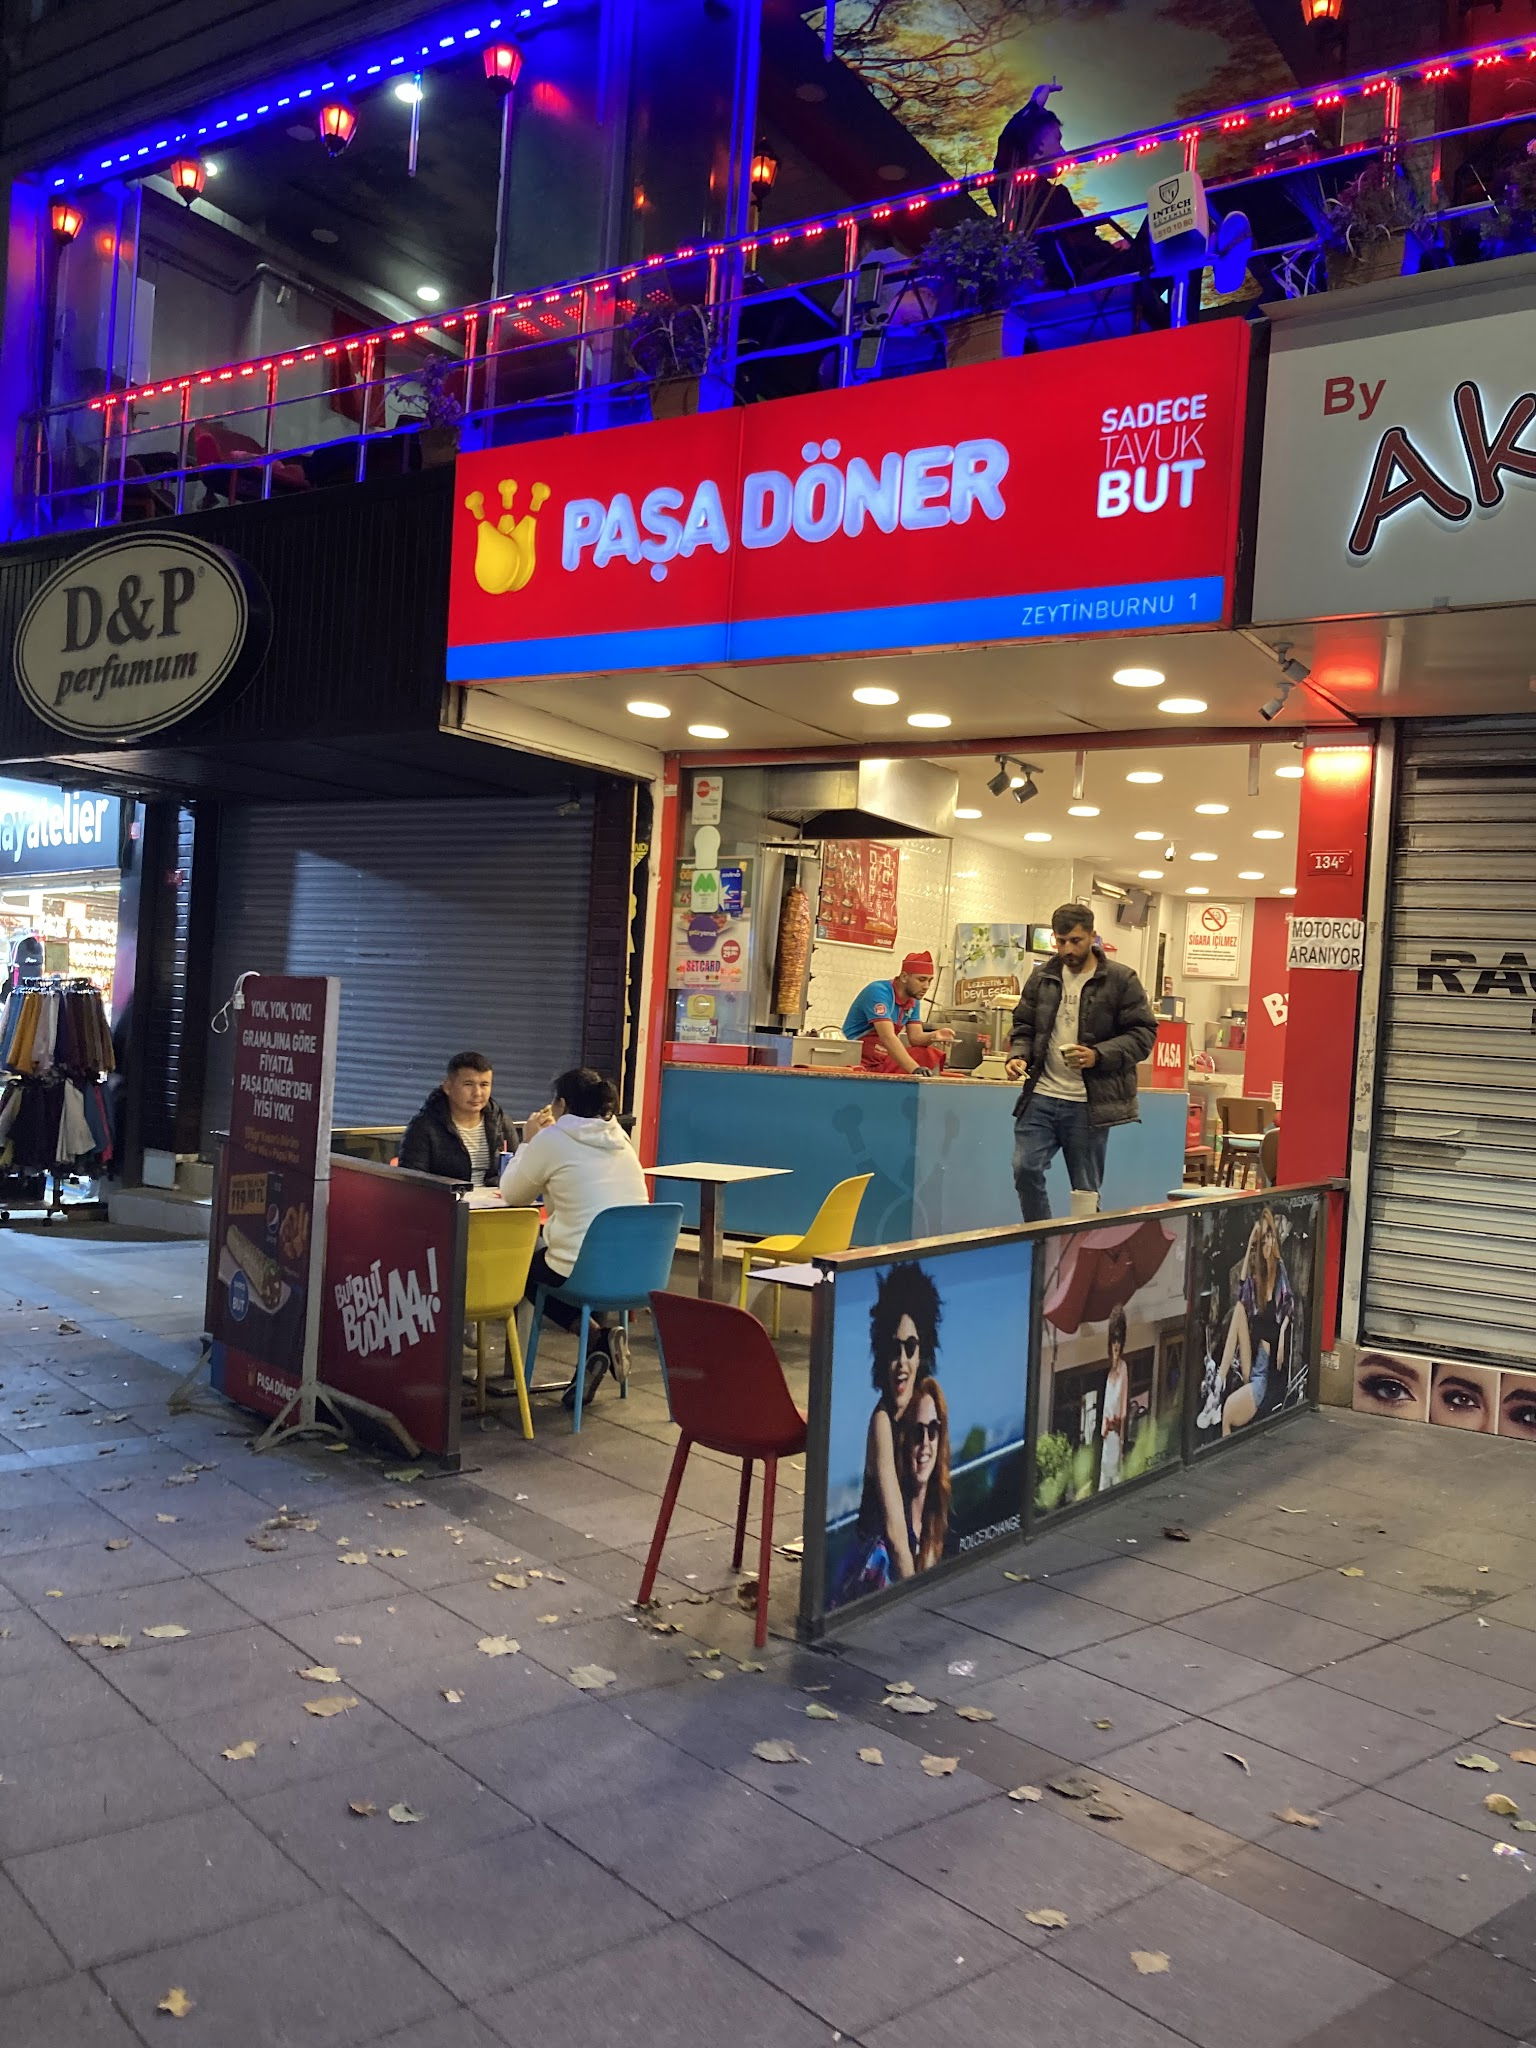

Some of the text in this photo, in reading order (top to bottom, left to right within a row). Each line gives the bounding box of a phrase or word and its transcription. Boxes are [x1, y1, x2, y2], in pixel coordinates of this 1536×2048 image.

[1153, 198, 1191, 220] INTECH
[1324, 376, 1386, 421] By
[1101, 394, 1208, 433] SADECE
[1099, 422, 1204, 468] TAVUK
[1096, 458, 1206, 519] BUT
[561, 438, 1009, 582] PAŞA DÖNER
[61, 566, 197, 653] D&P
[1021, 592, 1197, 626] ZEYTİNBURNU 1
[53, 653, 199, 706] perfumum
[1292, 921, 1361, 939] MOTORCU
[686, 960, 720, 972] SETCARD
[1289, 946, 1361, 965] ARANIYOR
[1417, 949, 1536, 995] RA
[251, 1000, 312, 1021] YOK, YOK, YOK!
[242, 1029, 317, 1053] GRAMAJINA GÖRE
[260, 1049, 294, 1074] FİYATTA
[1157, 1042, 1181, 1068] KASA
[240, 1073, 313, 1100] PAŞA DÖNER'DEN
[273, 1102, 294, 1122] YOK!
[334, 1259, 383, 1319] BUT BUT
[232, 1297, 245, 1313] BUT
